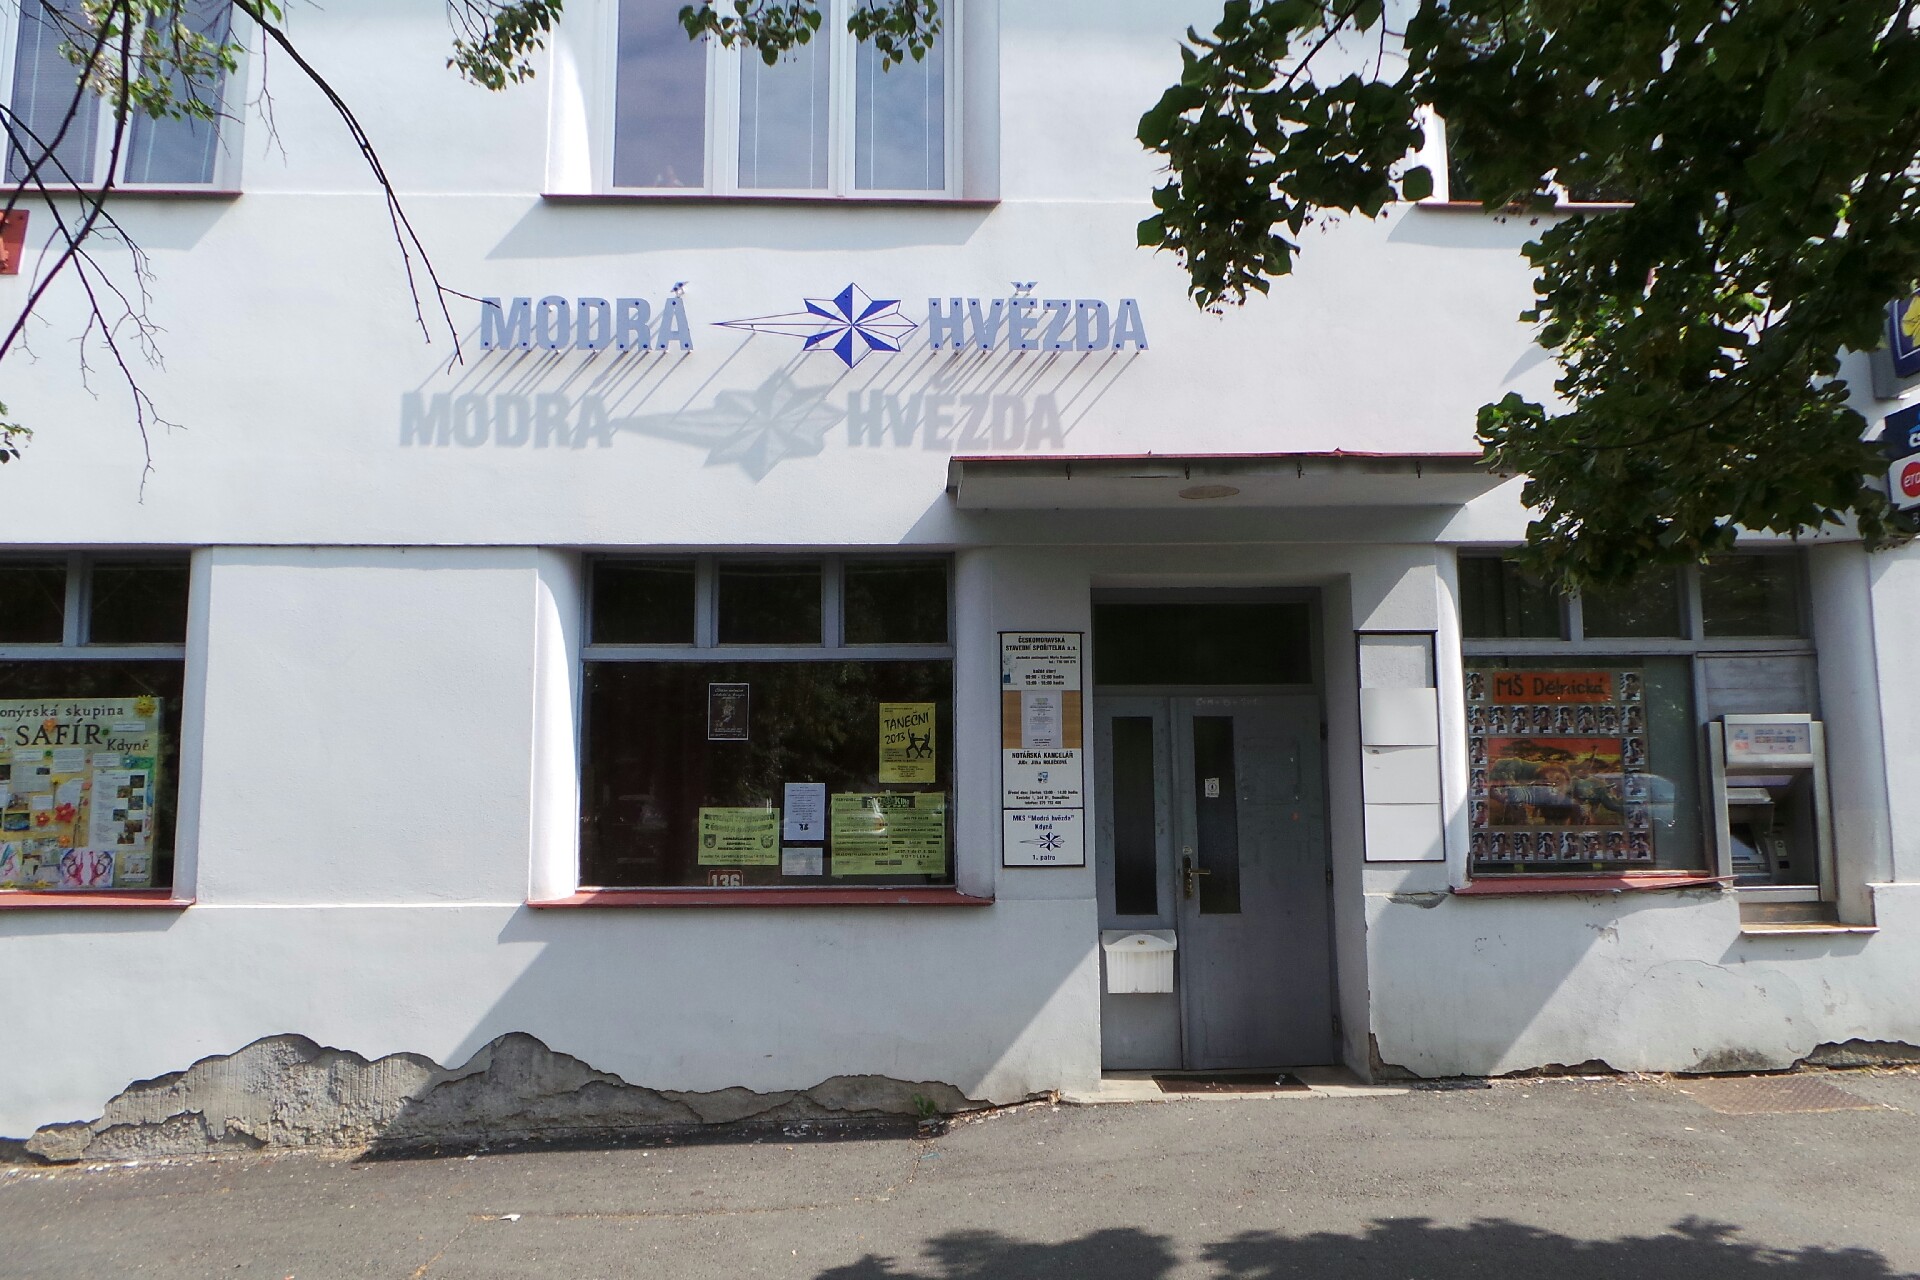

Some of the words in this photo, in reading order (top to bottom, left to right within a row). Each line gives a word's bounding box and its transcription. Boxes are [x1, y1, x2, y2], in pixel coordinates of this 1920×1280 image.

[480, 281, 694, 351] MODRÁ
[928, 281, 1149, 351] HVĚZDA
[1496, 674, 1524, 697] MŠ
[1533, 677, 1605, 696] Dělnická
[65, 704, 124, 720] skupina
[15, 718, 103, 746] SAFÍR
[884, 731, 906, 745] 2013
[106, 738, 150, 755] Kdyně
[1034, 823, 1053, 831] Kdyně
[711, 874, 741, 887] 136
